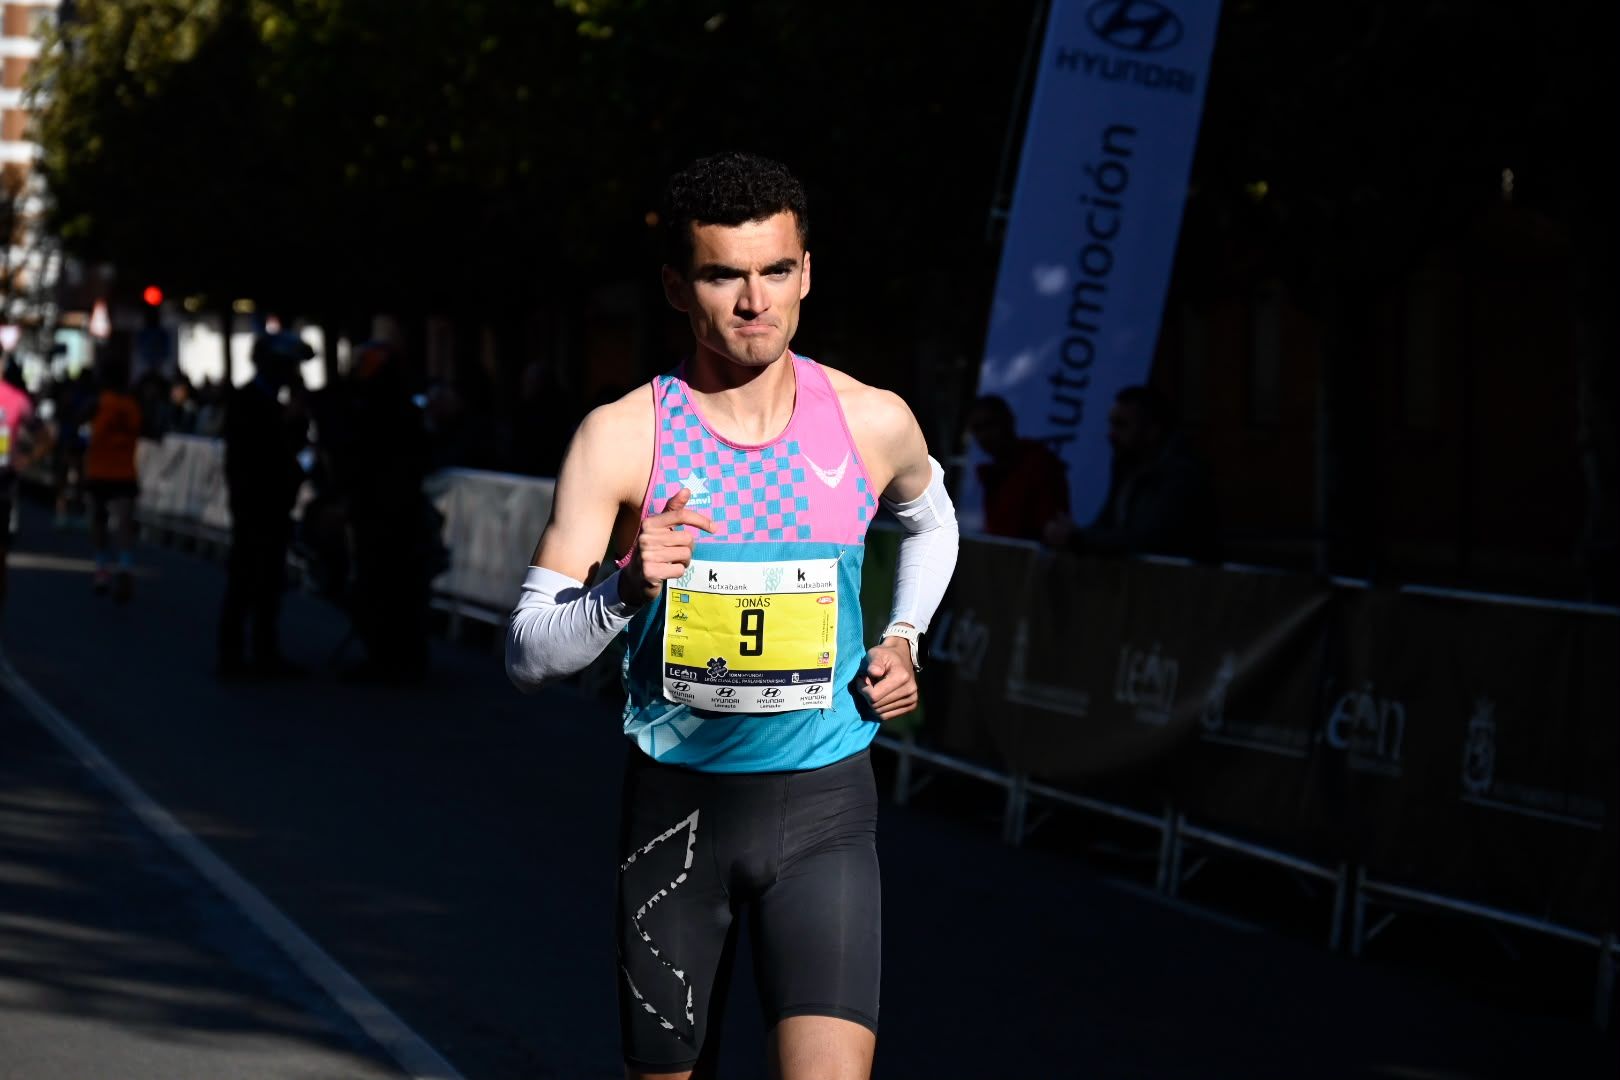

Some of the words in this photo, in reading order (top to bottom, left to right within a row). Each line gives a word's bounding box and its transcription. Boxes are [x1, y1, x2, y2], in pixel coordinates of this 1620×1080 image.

[1055, 47, 1196, 95] HYUNDAI
[708, 582, 749, 591] kutxabank
[796, 581, 833, 590] kutxabank
[735, 595, 771, 609] JONÁS
[739, 608, 765, 657] 9
